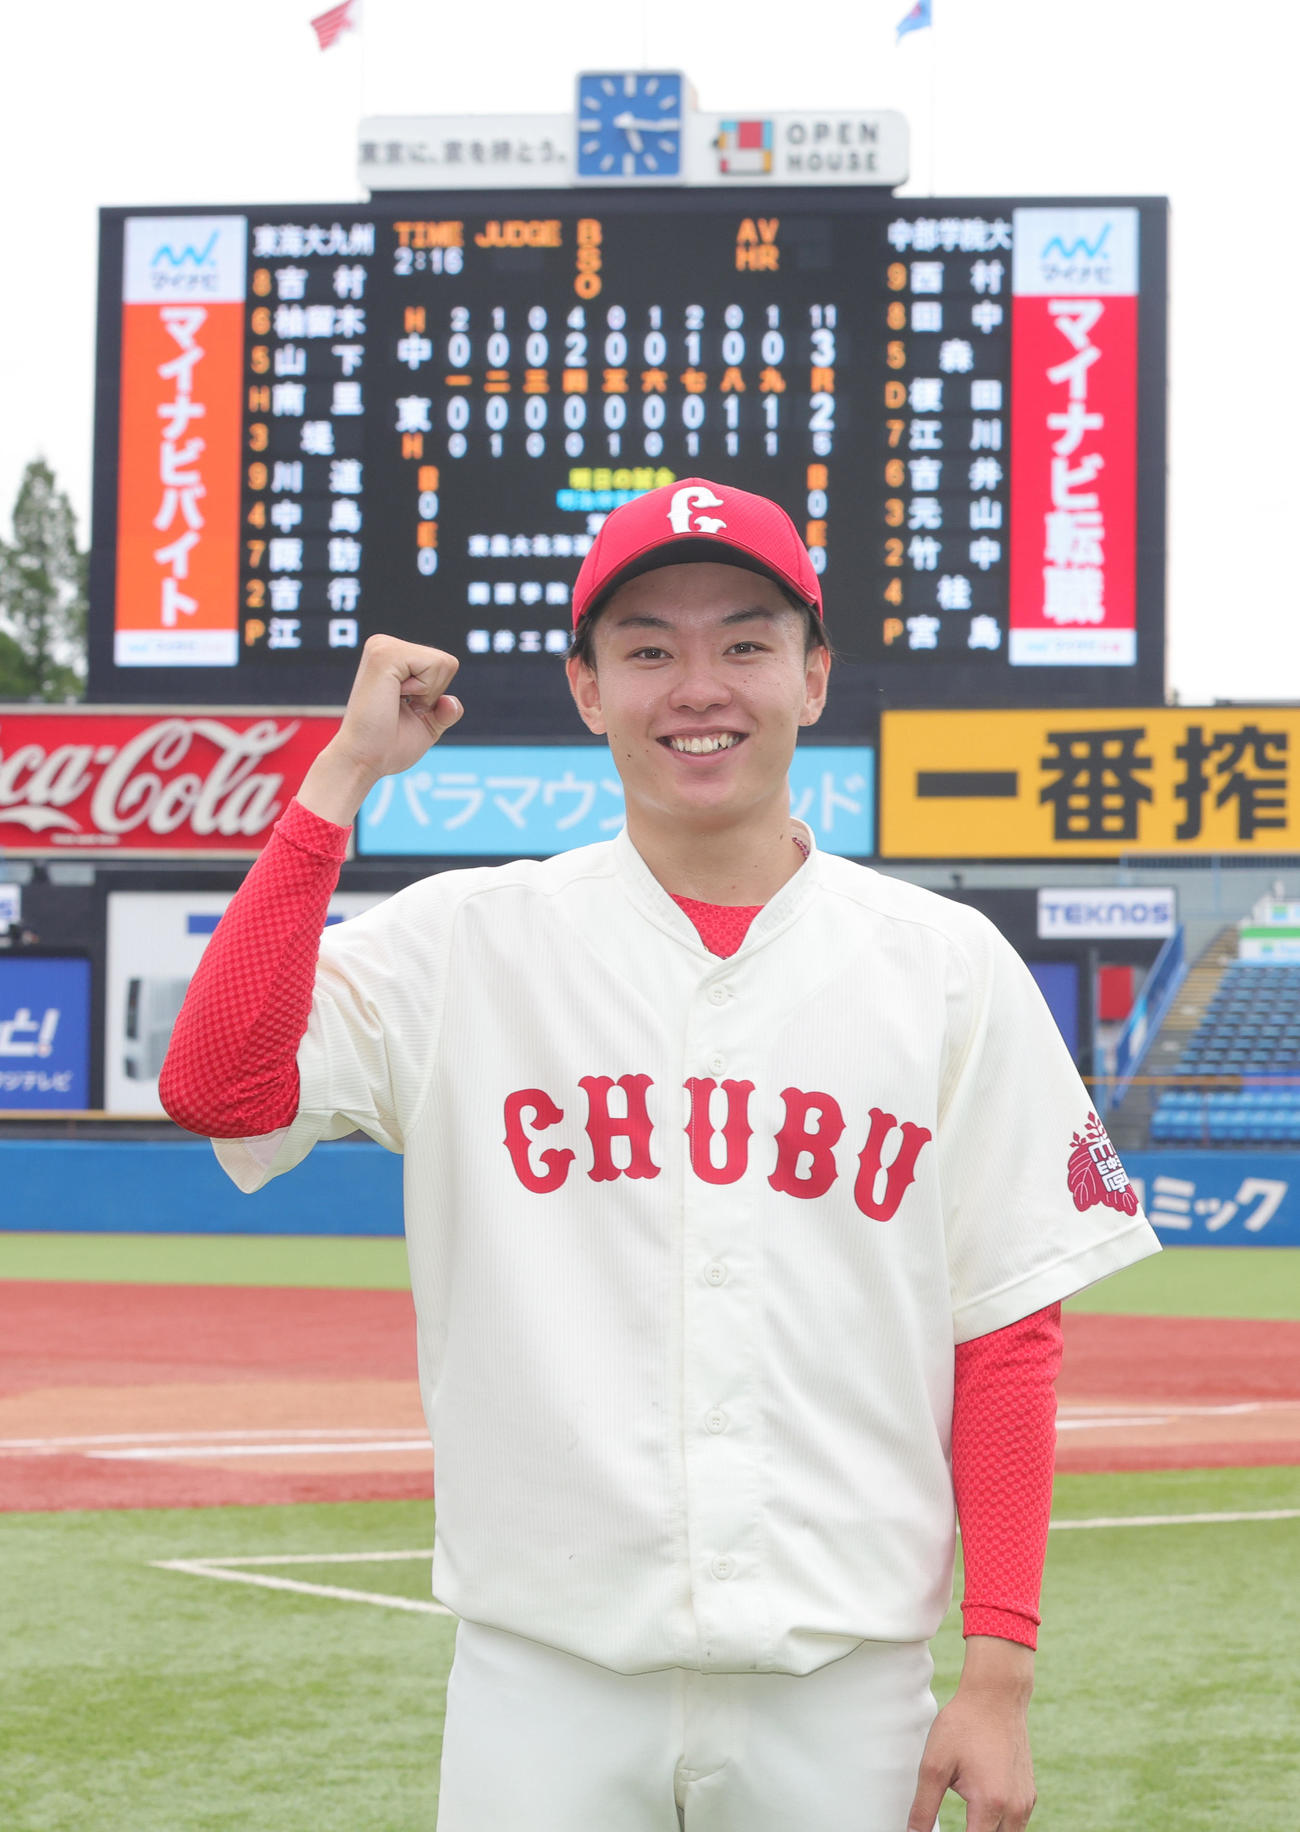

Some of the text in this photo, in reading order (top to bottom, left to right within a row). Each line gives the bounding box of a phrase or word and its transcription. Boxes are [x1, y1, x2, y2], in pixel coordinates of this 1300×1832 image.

[786, 120, 878, 146] OPEN
[786, 149, 879, 174] HOUSE
[394, 220, 464, 246] TIME
[474, 219, 562, 247] JUDGE
[736, 217, 779, 243] AV
[393, 246, 464, 275] 2:16
[735, 244, 780, 271] HR
[573, 272, 602, 298] O
[888, 263, 906, 290] 9
[451, 307, 469, 331] 2
[493, 307, 505, 331] 1
[528, 306, 547, 331] 0
[567, 307, 585, 330] 4
[607, 306, 626, 330] 0
[649, 306, 662, 330] 1
[686, 305, 704, 329] 2
[725, 305, 743, 329] 0
[767, 305, 779, 329] 1
[810, 305, 836, 330] 11
[252, 346, 269, 373] 5
[398, 329, 836, 370] 中 0 0 0 2 0 0 1 0 0 3
[887, 341, 905, 368] 5
[446, 376, 471, 385] 一
[485, 371, 510, 392] 二
[523, 369, 548, 393] 三
[642, 368, 667, 392] 六
[681, 368, 706, 392] 七
[721, 367, 745, 391] 八
[760, 367, 785, 392] 九
[885, 381, 906, 408] D
[447, 396, 470, 431] 0
[486, 396, 508, 430] 0
[525, 396, 547, 430] 0
[564, 395, 586, 430] 0
[604, 395, 626, 430] 0
[643, 395, 665, 429] 0
[682, 395, 705, 429] 0
[724, 395, 739, 429] 1
[763, 395, 778, 429] 1
[809, 392, 835, 430] 2
[250, 423, 267, 451] 3
[449, 433, 467, 458] 0
[490, 433, 502, 457] 1
[526, 433, 545, 457] 0
[565, 432, 584, 457] 0
[608, 432, 620, 456] 1
[644, 432, 663, 457] 0
[686, 432, 699, 456] 1
[726, 432, 738, 456] 1
[765, 432, 778, 456] 1
[887, 420, 904, 446] 7
[148, 307, 210, 628] マイナビバイト
[886, 459, 904, 486] 6
[1043, 300, 1105, 624] マイナビ転職
[248, 502, 265, 528] 4
[416, 491, 440, 519] 0
[807, 490, 828, 518] 0
[886, 499, 903, 526] 3
[248, 540, 265, 567] 7
[416, 548, 439, 575] 0
[809, 547, 827, 575] 0
[886, 538, 903, 566] 2
[247, 579, 264, 607] 2
[885, 579, 902, 604] 4
[245, 619, 265, 645] P
[884, 618, 903, 644] P
[0, 718, 301, 836] ca-Cola
[915, 724, 1289, 843] 一番搾
[1042, 902, 1170, 924] TEKNOS
[503, 1073, 932, 1222] CHUBU
[1130, 1175, 1288, 1232] ミック
